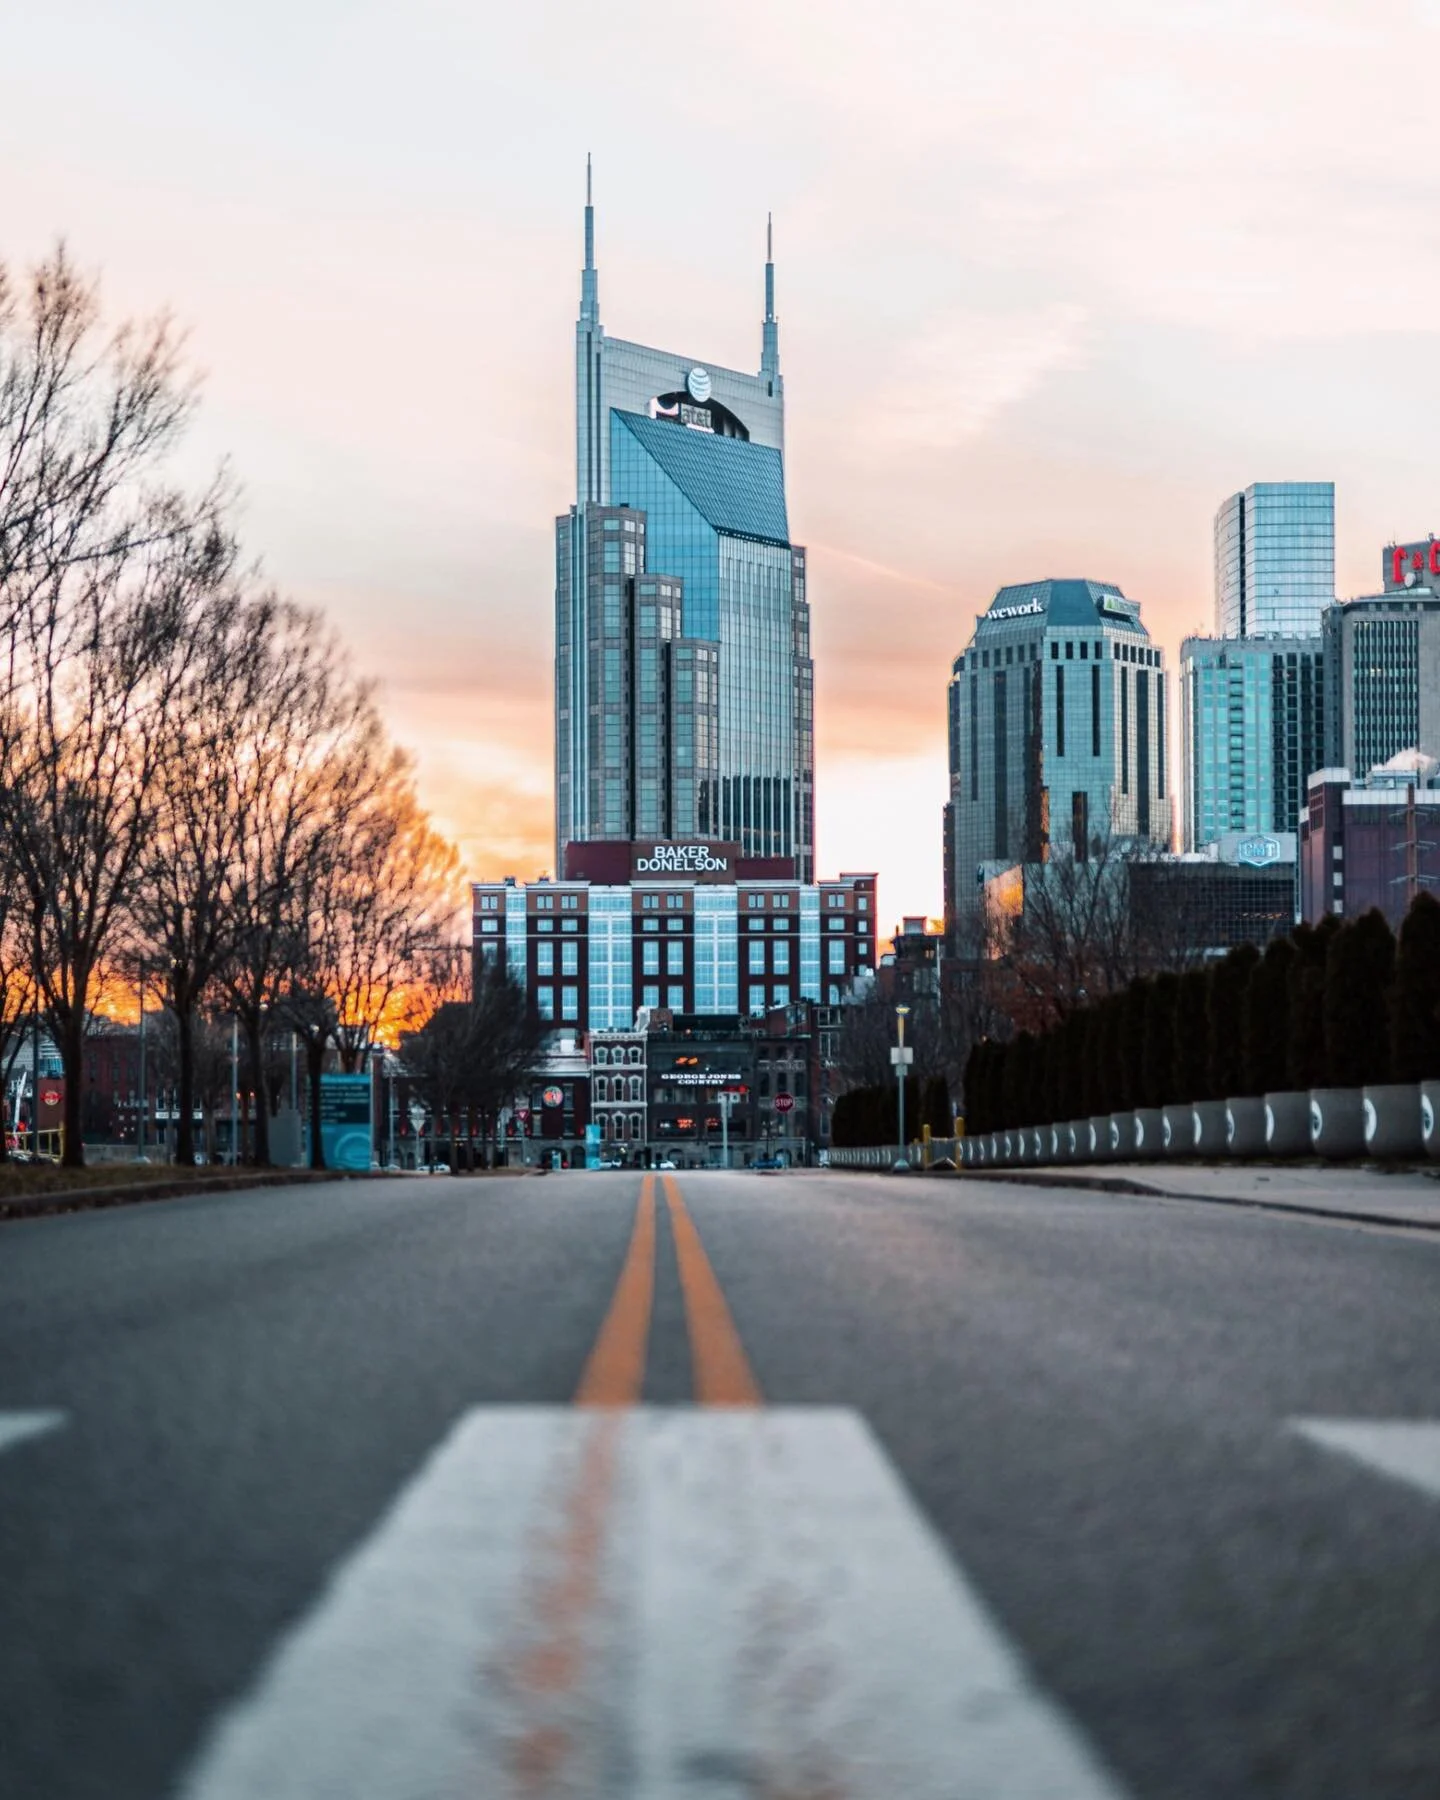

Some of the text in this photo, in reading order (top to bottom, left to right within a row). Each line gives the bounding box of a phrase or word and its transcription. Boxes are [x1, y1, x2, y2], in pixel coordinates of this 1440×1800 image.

[987, 597, 1043, 619] wework
[654, 846, 709, 858] BAKER
[637, 858, 727, 871] DONELSON
[775, 1098, 794, 1107] STOP
